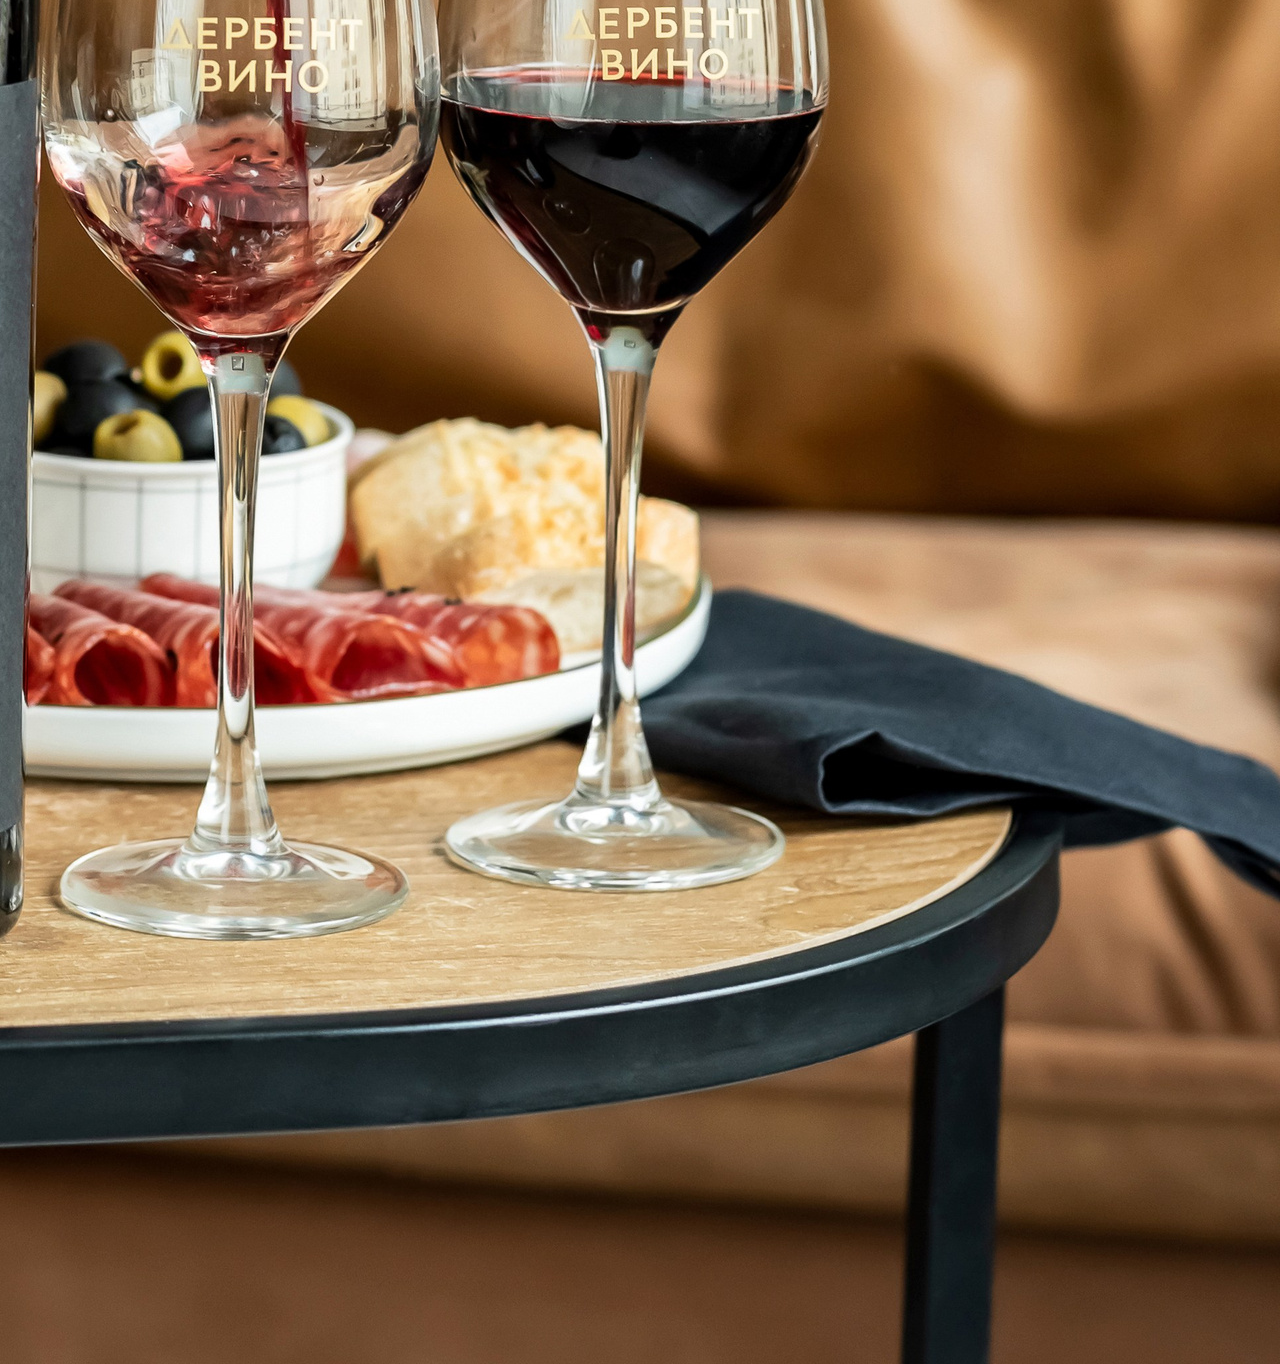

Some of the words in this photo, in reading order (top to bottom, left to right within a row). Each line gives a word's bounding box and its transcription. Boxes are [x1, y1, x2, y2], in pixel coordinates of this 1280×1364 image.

[161, 16, 364, 51] ДЕРБЕНТ
[566, 6, 760, 40] ДЕРБЕНТ
[198, 59, 329, 94] ВИНО
[601, 48, 729, 81] ВИНО
